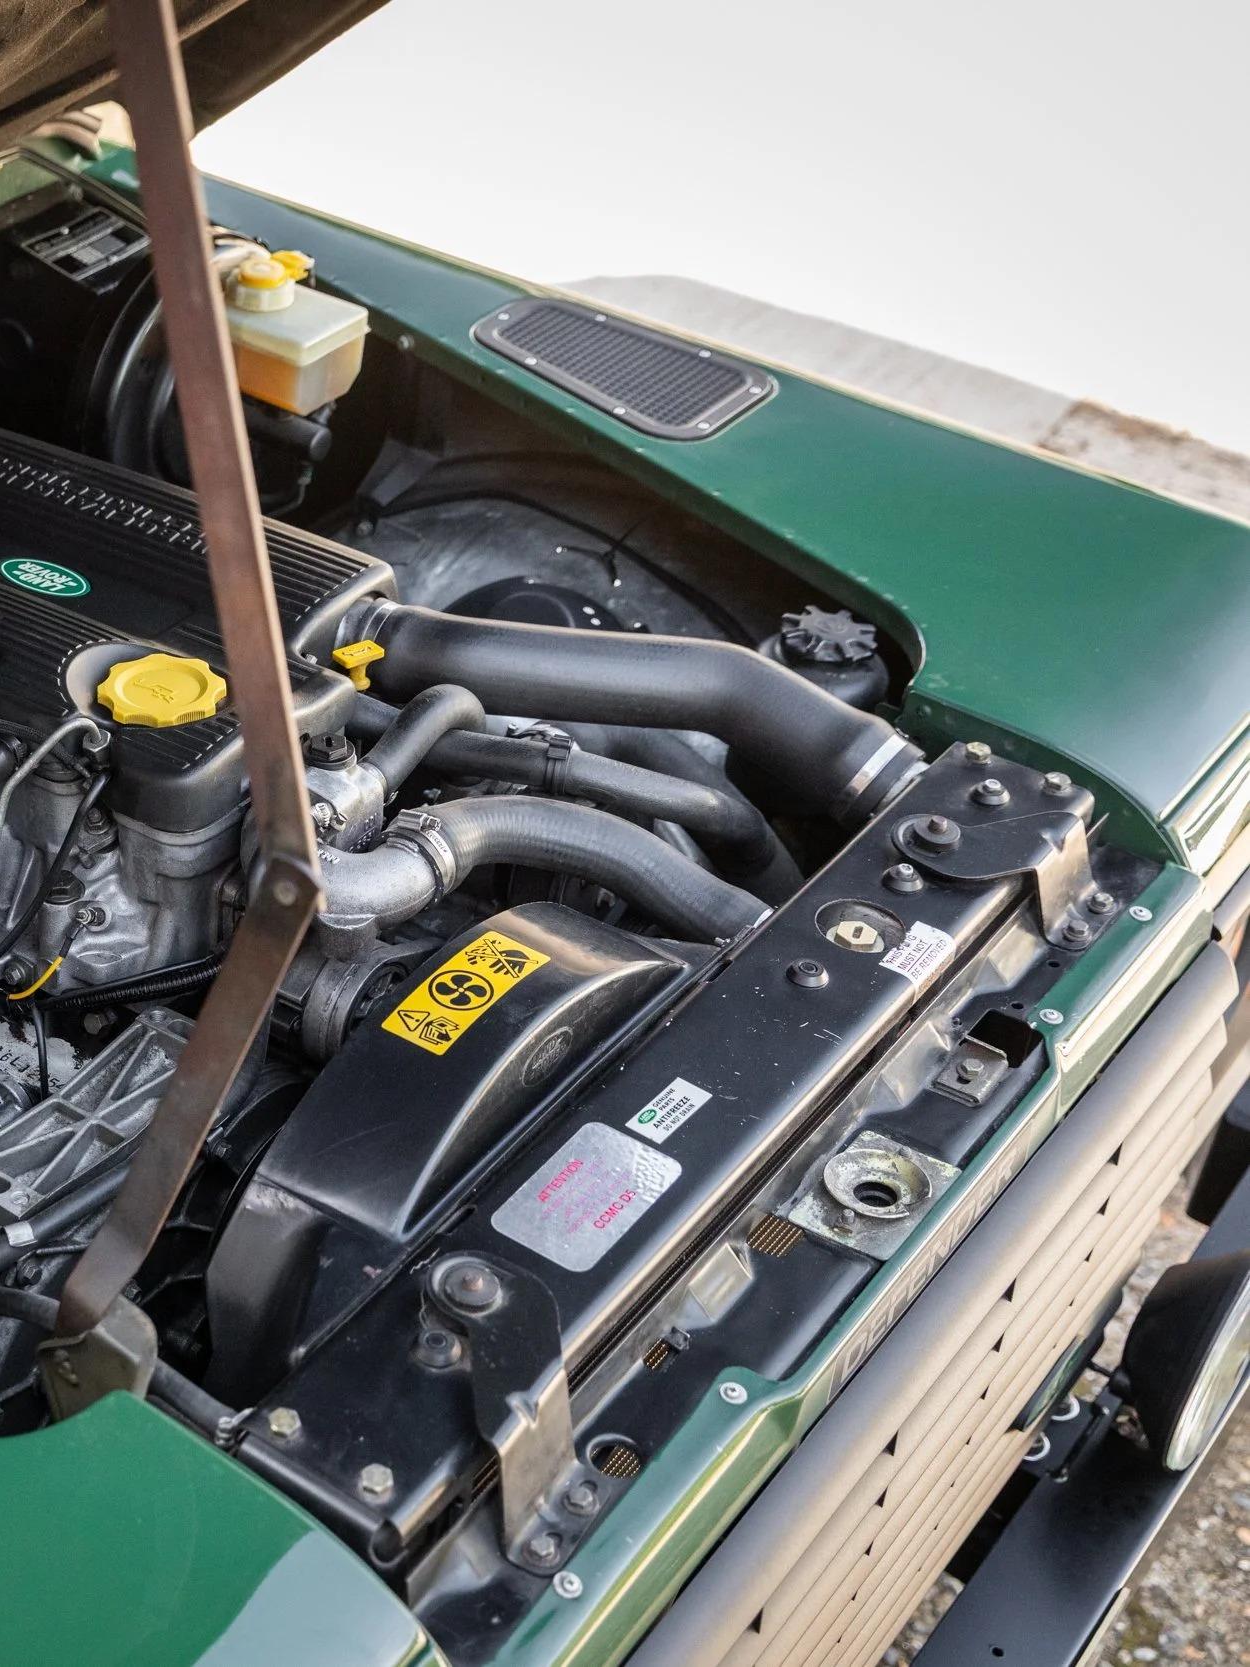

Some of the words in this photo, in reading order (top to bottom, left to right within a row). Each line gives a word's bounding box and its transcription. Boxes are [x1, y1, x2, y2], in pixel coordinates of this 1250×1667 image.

[17, 562, 73, 584] ROVER
[18, 573, 66, 591] LAND
[886, 947, 903, 964] THIS
[897, 952, 916, 970] MUST
[912, 939, 929, 954] NOT
[911, 967, 923, 980] BE
[919, 939, 947, 970] REMOVED
[652, 1088, 676, 1107] GENUINE
[653, 1095, 691, 1129] ANTIFREEZE
[658, 1097, 675, 1111] PARTS
[663, 1123, 673, 1131] DO
[670, 1115, 682, 1125] NOT
[679, 1103, 696, 1117] DRAIN
[537, 1158, 584, 1202] ATTENTION
[593, 1200, 625, 1230] CCMC
[619, 1188, 637, 1203] D5
[835, 1154, 1015, 1380] DEFENDER
